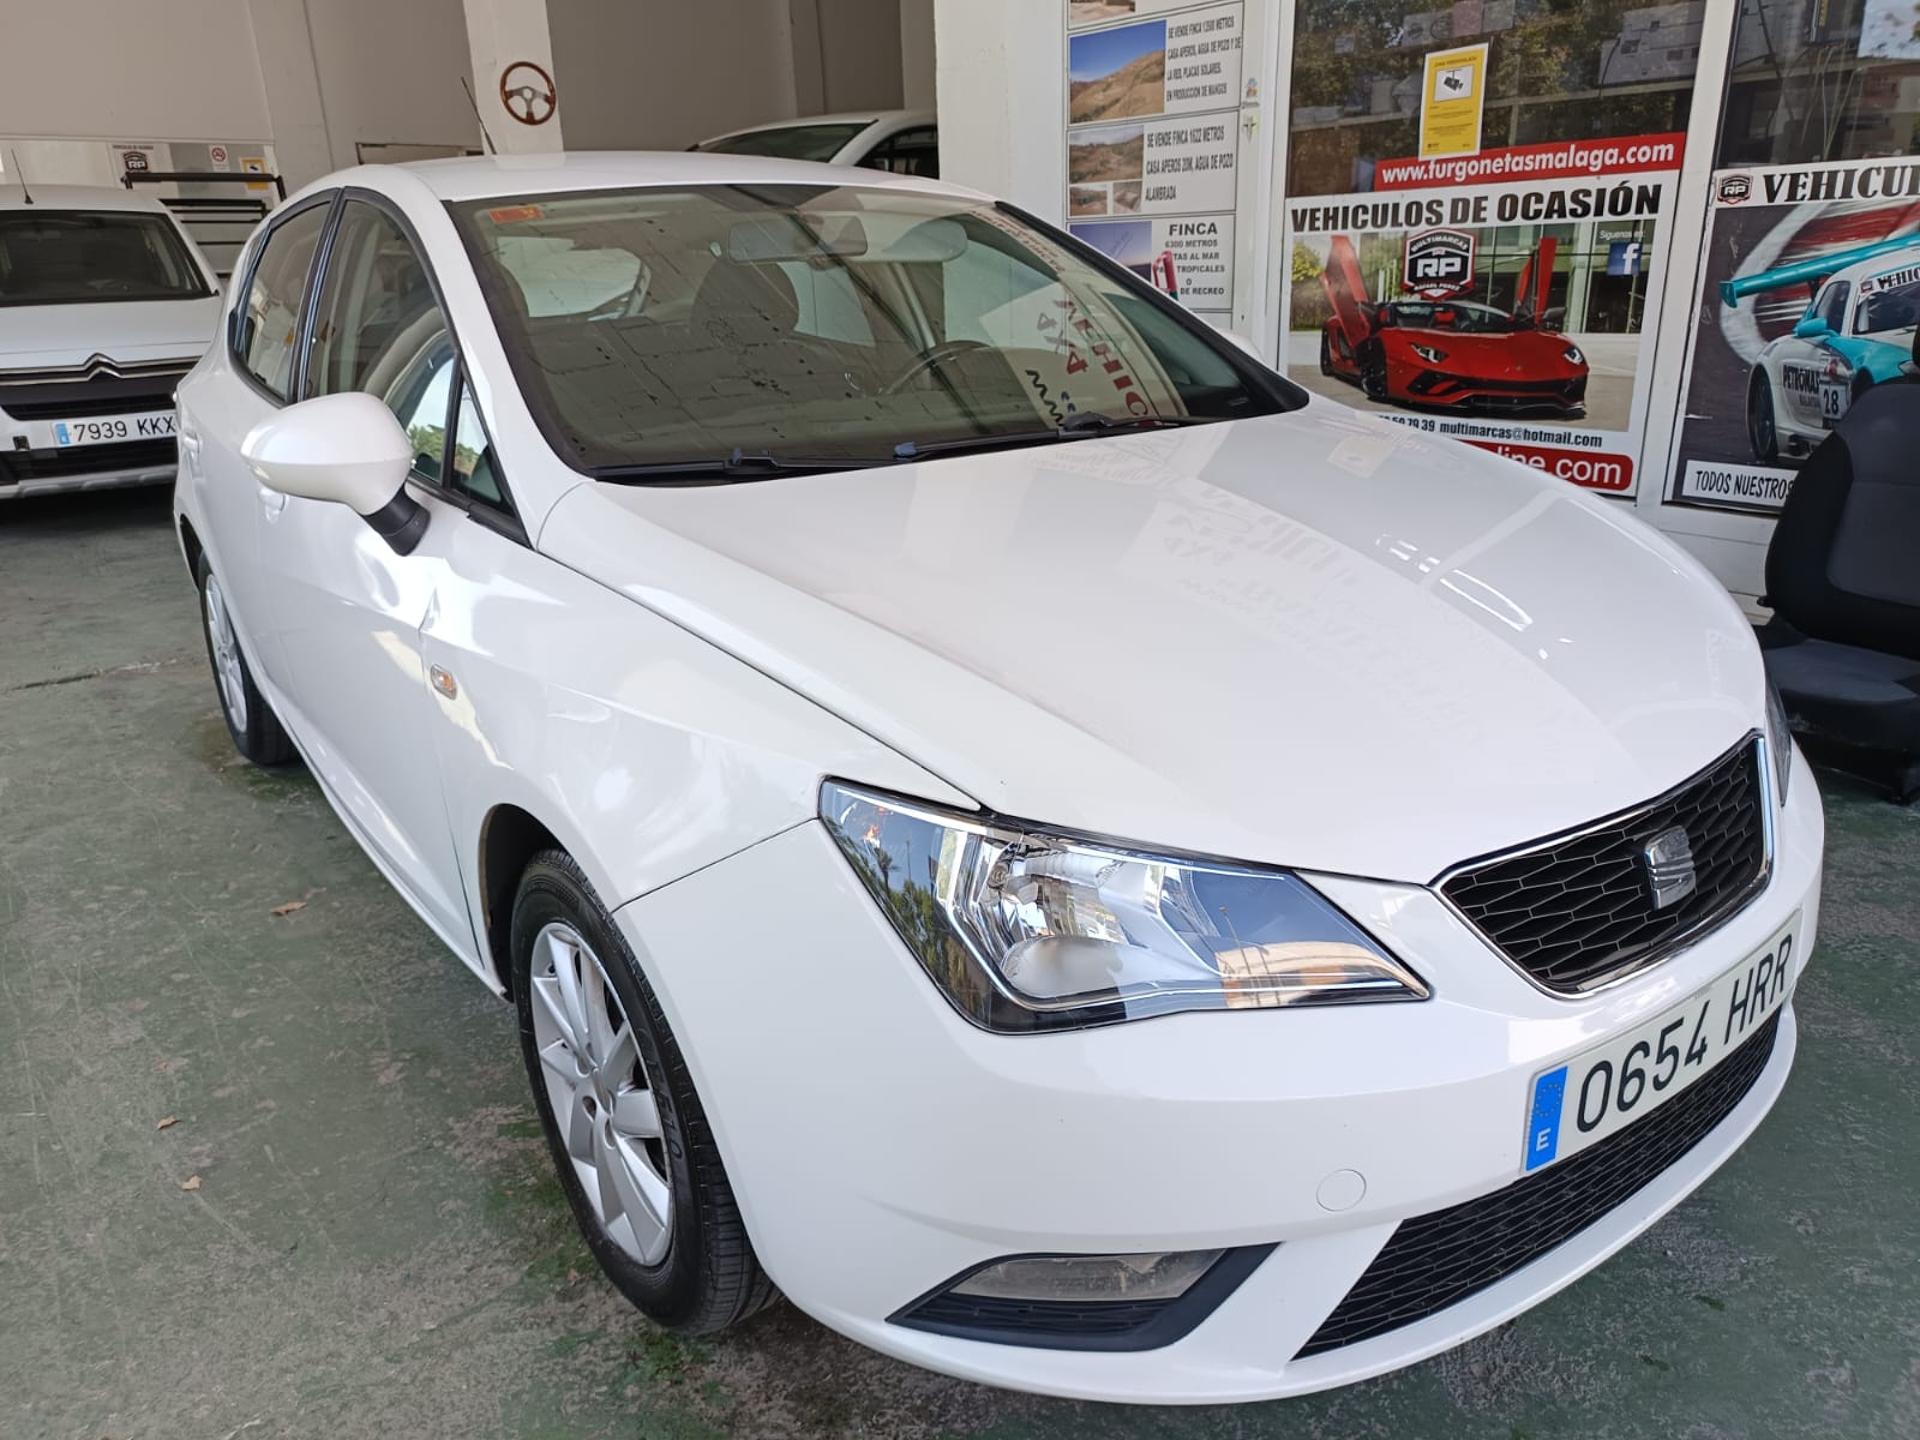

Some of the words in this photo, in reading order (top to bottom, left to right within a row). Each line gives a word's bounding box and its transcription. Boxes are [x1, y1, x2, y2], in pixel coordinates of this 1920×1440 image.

[1155, 131, 1172, 147] VENDE
[1172, 128, 1188, 144] FINCA
[1203, 125, 1224, 142] METROS
[1381, 143, 1675, 183] www.furgonetasmalaga.com
[1291, 199, 1444, 232] VEHICULOS
[1449, 196, 1488, 225] DE
[1496, 180, 1662, 222] OCASIÓN
[1169, 222, 1218, 236] FINCA
[1185, 240, 1218, 248] METROS
[1190, 252, 1200, 260] AL
[1202, 252, 1220, 260] MAR
[1177, 265, 1225, 273] TROPICALES
[1417, 257, 1461, 278] RP
[1824, 388, 1839, 414] 28
[73, 420, 128, 442] 7939
[136, 415, 176, 436] KKX
[1421, 419, 1435, 432] 39
[1439, 421, 1602, 448] multimarcas@hotmail.com
[1696, 470, 1732, 494] TODOS
[1576, 999, 1712, 1134] 0654
[1724, 933, 1793, 1045] HRR
[1536, 1128, 1551, 1152] E
